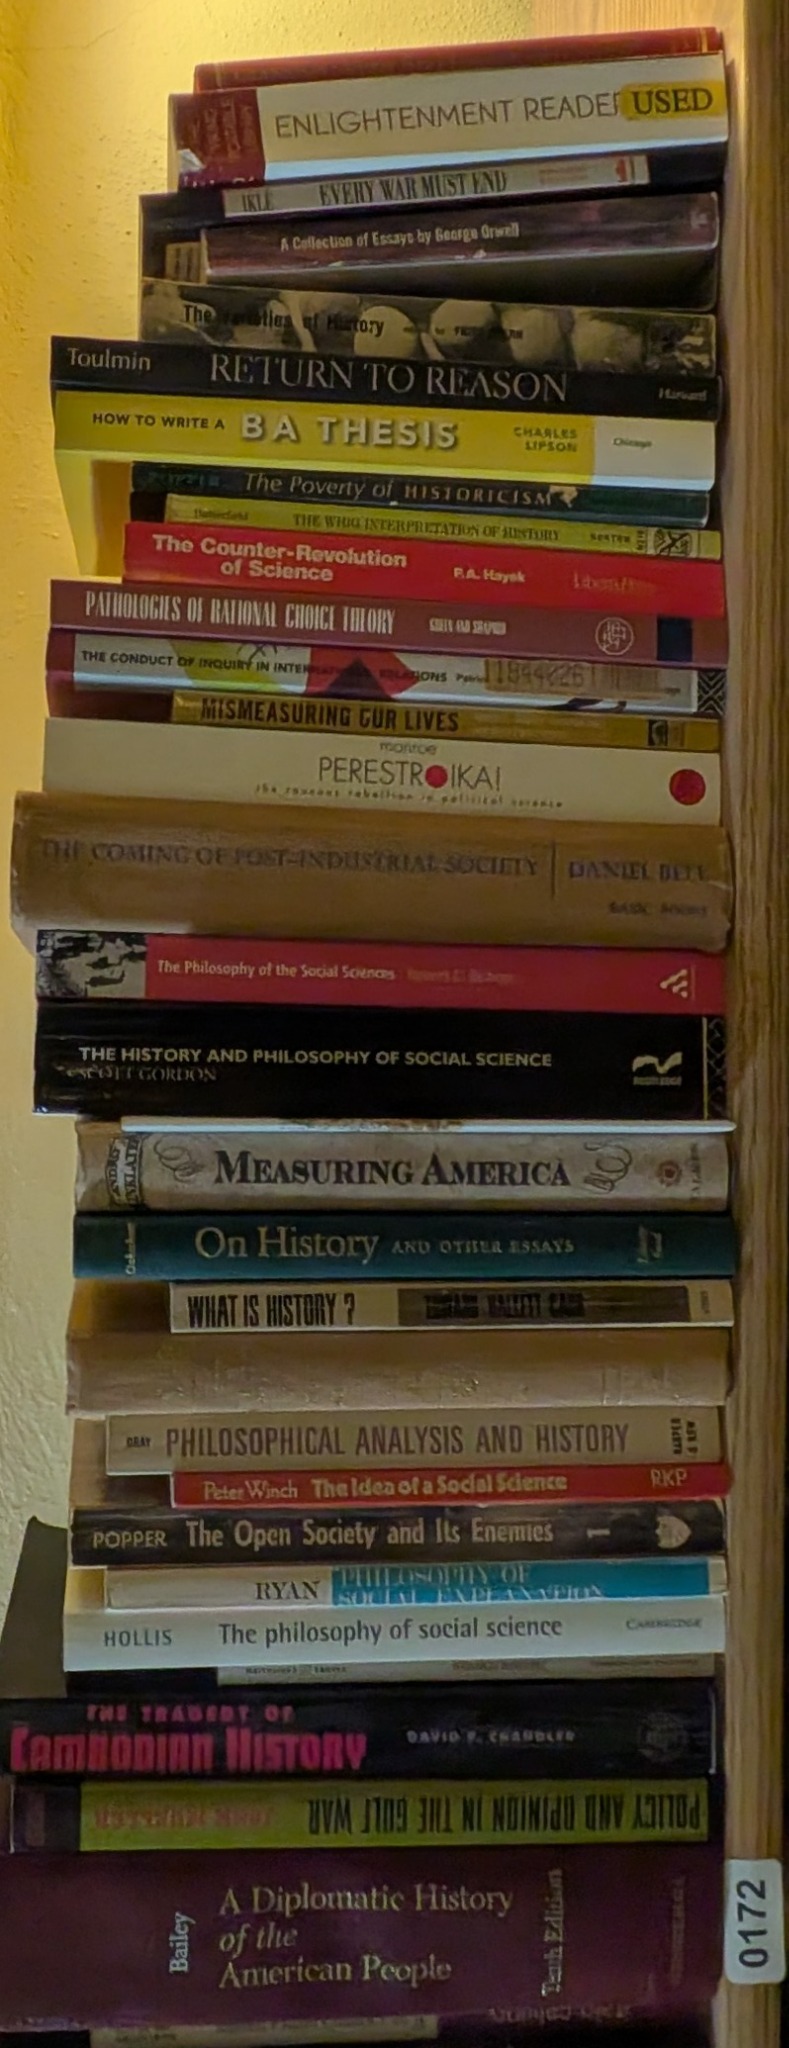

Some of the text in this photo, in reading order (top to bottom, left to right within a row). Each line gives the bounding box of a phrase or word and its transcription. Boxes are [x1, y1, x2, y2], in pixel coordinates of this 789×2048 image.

[275, 98, 514, 138] ENLIGHTENMENT
[632, 88, 712, 115] USED
[319, 169, 507, 206] EVERY WAR MUST END
[281, 222, 519, 252] A Collection of Essays by George Orwell
[184, 304, 212, 323] The
[327, 312, 384, 336] History
[67, 347, 150, 372] Toulmin
[211, 354, 566, 402] RETURN TO REASON
[93, 413, 225, 429] HOW TO WRITE A
[242, 414, 458, 450] BA THESIS
[513, 427, 577, 439] CHARLES
[525, 441, 577, 452] LIPSON
[246, 473, 551, 506] The Poverty of HISTORICISM
[293, 513, 560, 541] THE WHIG INTERPRETATION OF HISTORY
[153, 534, 407, 567] The Counter-Revolution
[221, 559, 333, 582] of Science
[484, 569, 525, 583] Hayek
[86, 590, 396, 635] PATHOLOGIES OF RATIONAL CHOICE THEORY
[81, 651, 105, 663] THE
[110, 652, 173, 666] CONDUCT
[178, 655, 194, 667] OF
[199, 657, 250, 671] INQUIRY
[256, 661, 269, 673] IN
[200, 697, 349, 727] MISMEASURING
[405, 711, 459, 732] LIVES
[256, 783, 277, 793] the
[348, 786, 414, 801] rebellion
[422, 793, 433, 803] in
[442, 793, 503, 806] political
[42, 839, 80, 862] THE
[92, 842, 190, 865] COMING
[196, 845, 224, 866] OF
[448, 853, 537, 876] SOCIETY
[568, 860, 709, 882] DANIEL BELL
[158, 960, 180, 974] The
[184, 961, 255, 978] Philosophy
[259, 962, 272, 976] of
[276, 963, 298, 977] the
[301, 964, 338, 979] Social
[342, 966, 395, 980] Sciences
[79, 1047, 551, 1067] THE HISTORY AND PHILOSOPHY OF SOCIAL SCIENCE
[139, 1066, 216, 1082] GORDON
[215, 1150, 571, 1186] MEASURING AMERICA
[195, 1226, 574, 1265] On History AND OTHER ESSAYS
[188, 1295, 238, 1327] WHAT
[244, 1295, 259, 1327] IS
[266, 1293, 336, 1326] HISTORY
[166, 1423, 629, 1457] PHILOSOPHICAL ANALYSIS AND HISTORY
[204, 1479, 298, 1500] Peter Winch
[311, 1472, 567, 1498] The Idea of a Social Science
[651, 1468, 688, 1487] RKP
[92, 1529, 168, 1549] POPPER
[186, 1514, 553, 1552] The Open Society and Its Enemies
[255, 1579, 320, 1600] RYAN
[339, 1563, 531, 1587] PHILOSOPHY OF
[104, 1629, 173, 1647] HOLLIS
[219, 1616, 562, 1651] The philosophy of social science
[87, 1704, 296, 1723] THE TRAGEDY OF
[225, 1726, 367, 1770] HISTORY
[406, 1729, 460, 1744] DAVID
[489, 1729, 576, 1743] CHANDLER
[308, 1797, 352, 1835] WAR
[361, 1796, 407, 1834] GULF
[418, 1795, 452, 1833] THE
[462, 1795, 483, 1832] IN
[492, 1794, 575, 1832] OPINION
[585, 1793, 623, 1830] AND
[633, 1793, 700, 1830] POLICY
[218, 1883, 513, 1918] A Diplomatic History
[218, 1921, 298, 1958] of the
[541, 1868, 563, 1997] Tenth Edition
[737, 1879, 768, 1968] 0172
[169, 1911, 196, 1974] Bailey
[218, 1952, 452, 1989] American People
